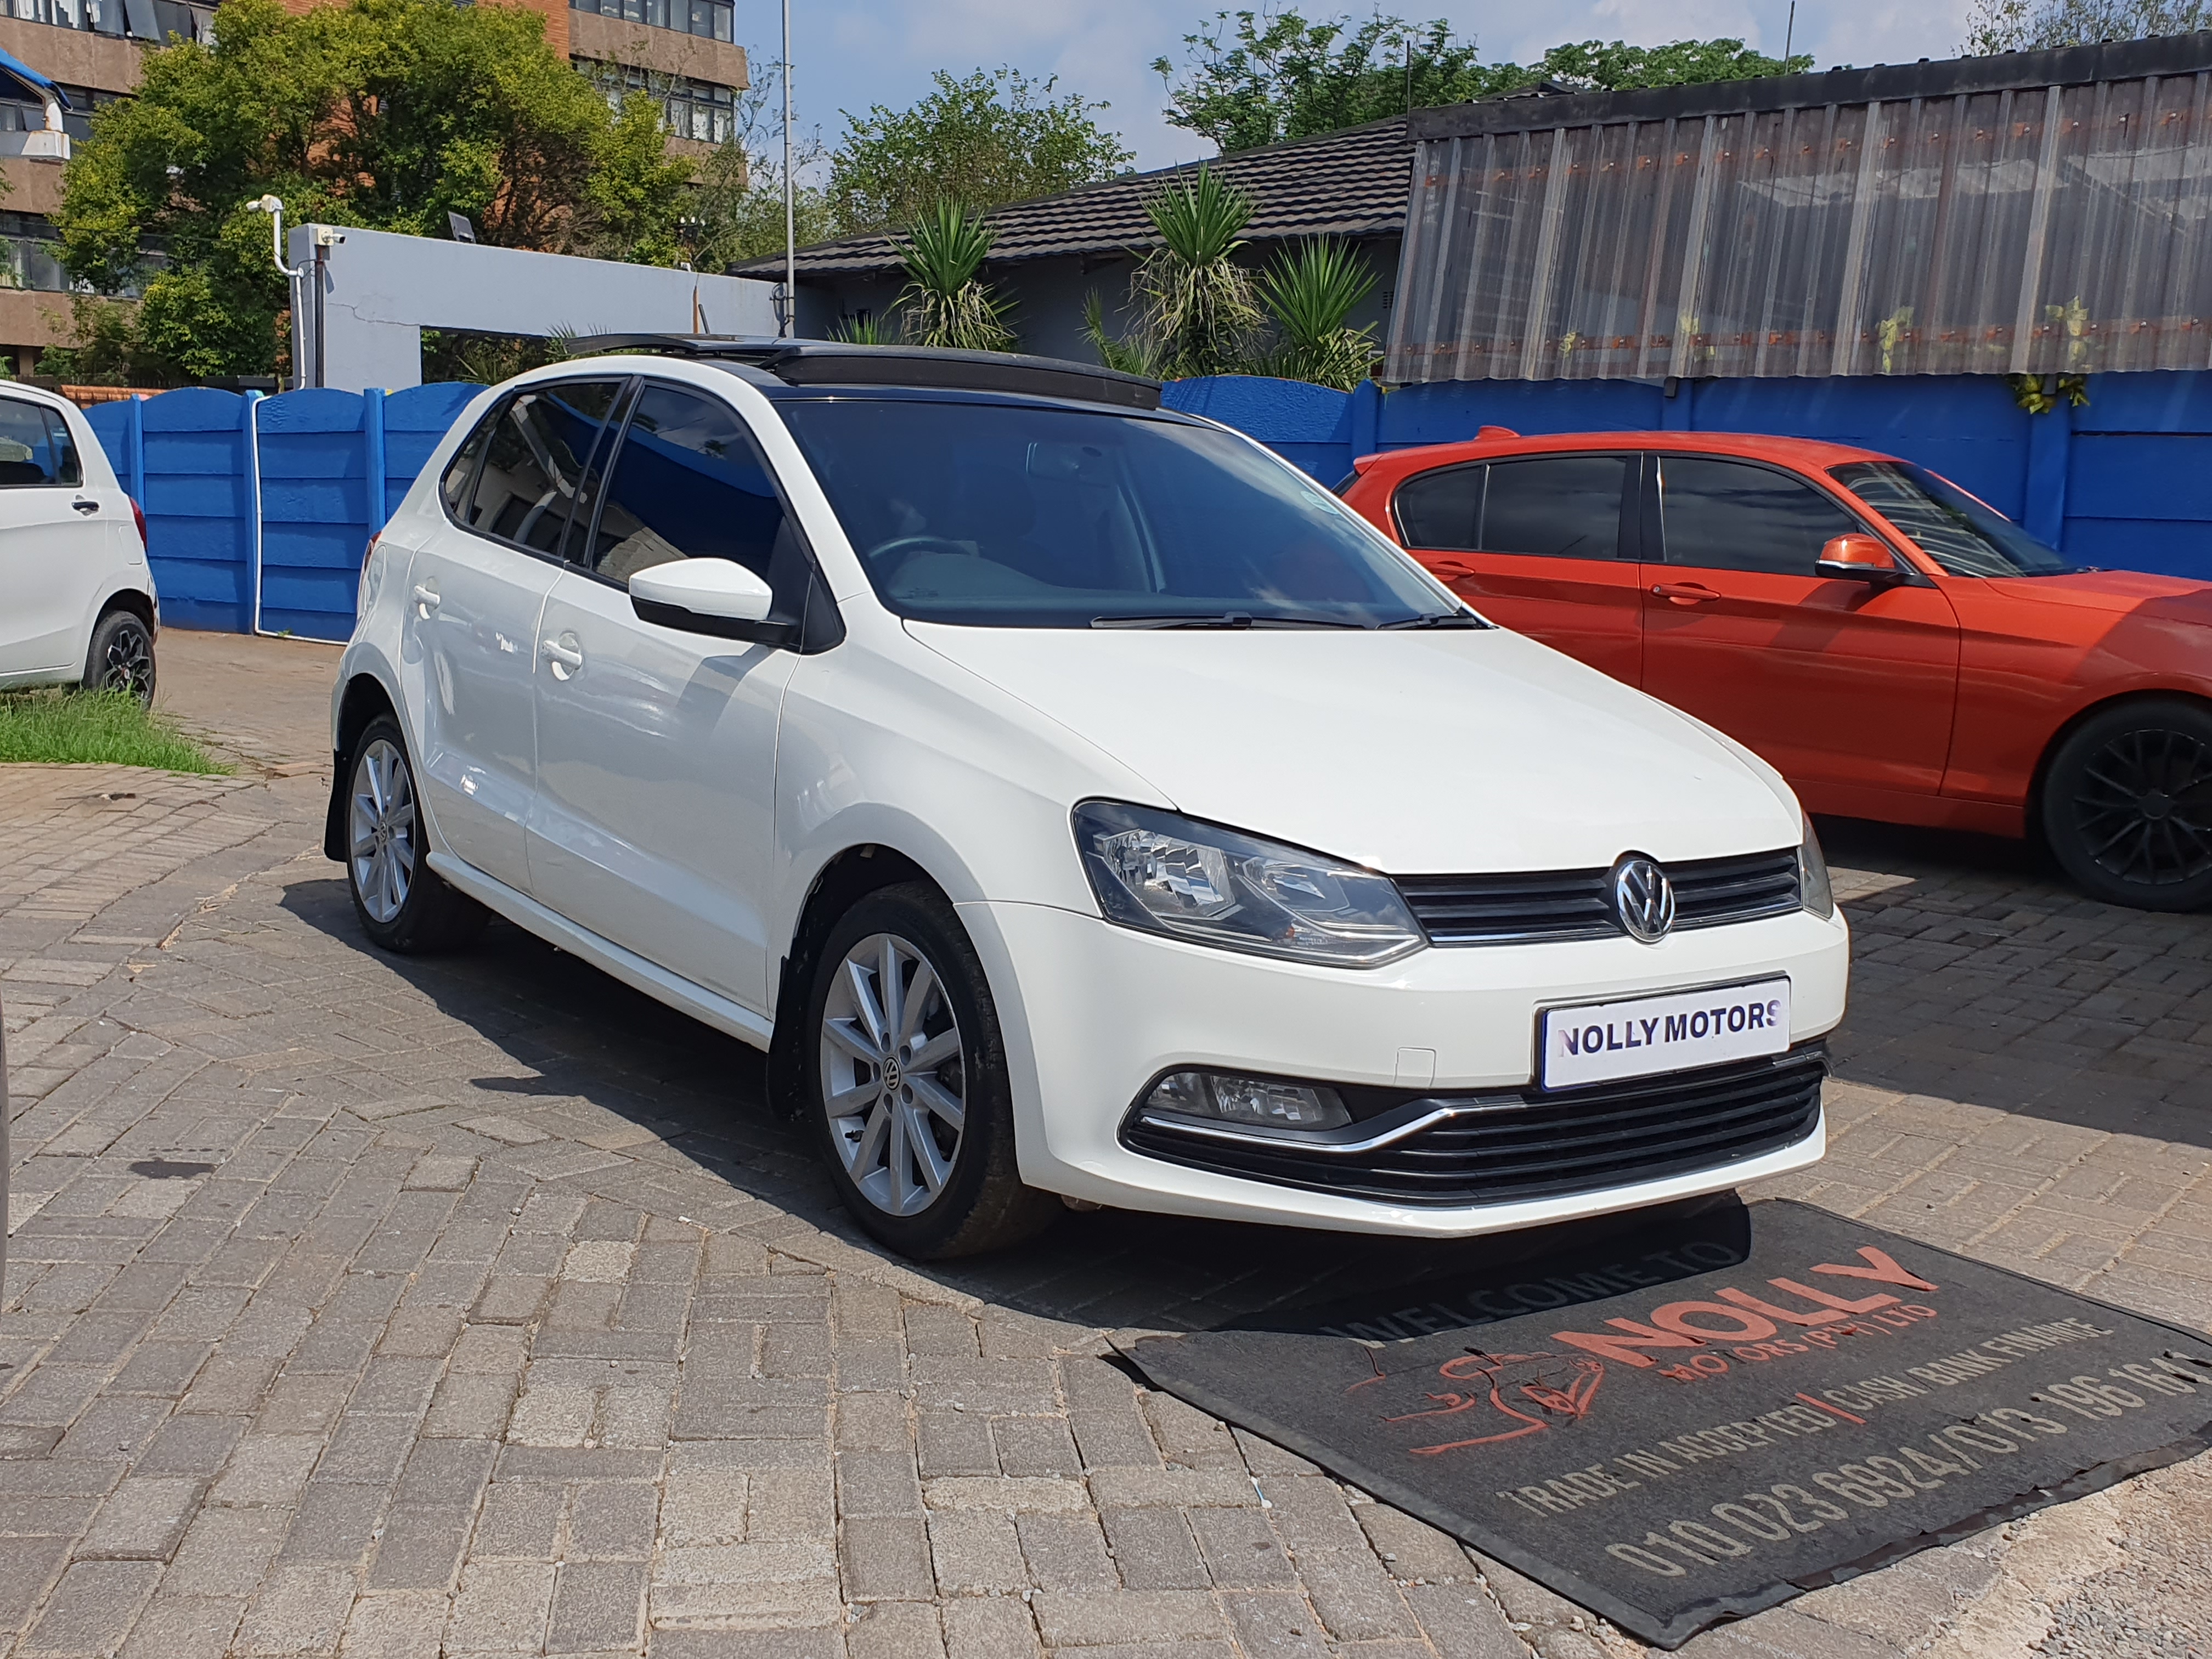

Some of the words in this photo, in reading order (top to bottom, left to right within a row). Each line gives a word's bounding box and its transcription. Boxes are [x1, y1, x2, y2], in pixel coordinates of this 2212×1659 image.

[1557, 1017, 1660, 1058] NOLLY
[1664, 999, 1782, 1043] MOTORS
[1320, 1262, 1662, 1348] WELCOME
[1644, 1240, 1745, 1273] TO
[1551, 1244, 1940, 1368] NOLLY
[1872, 1304, 1938, 1327] LTD
[1494, 1463, 1642, 1517] TRADE
[1612, 1448, 1684, 1479] IN
[1657, 1404, 1837, 1463] ACCEPTED
[1979, 1317, 2114, 1358] FINANCE
[1604, 1520, 1753, 1577] 010
[1710, 1483, 1849, 1541] 023
[2030, 1375, 2146, 1421] 196
